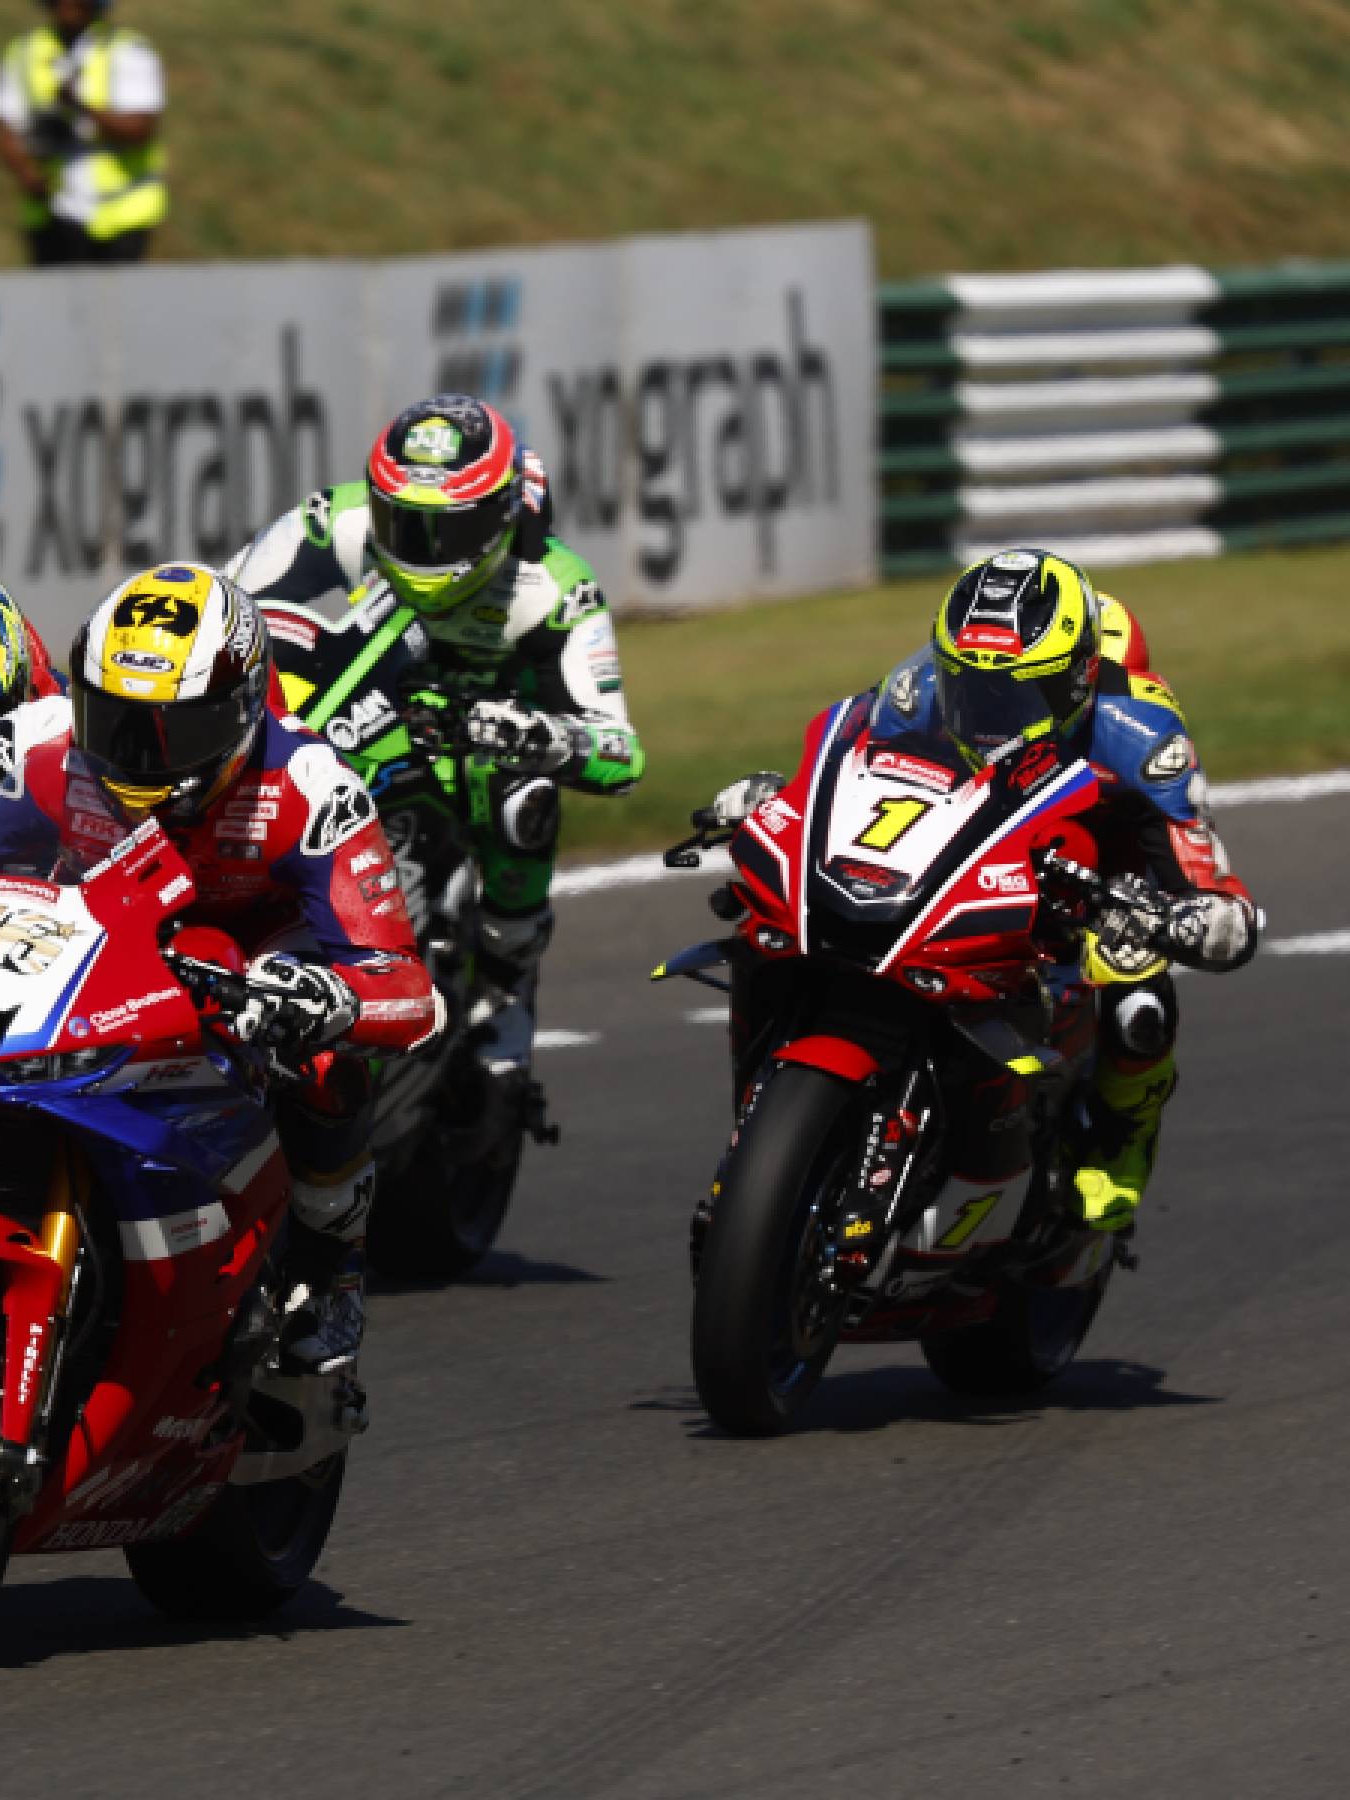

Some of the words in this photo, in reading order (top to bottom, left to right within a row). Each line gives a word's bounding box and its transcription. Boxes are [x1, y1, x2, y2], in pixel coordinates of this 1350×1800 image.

[21, 321, 332, 581] xograph
[545, 287, 839, 588] xograph
[852, 796, 934, 853] 1
